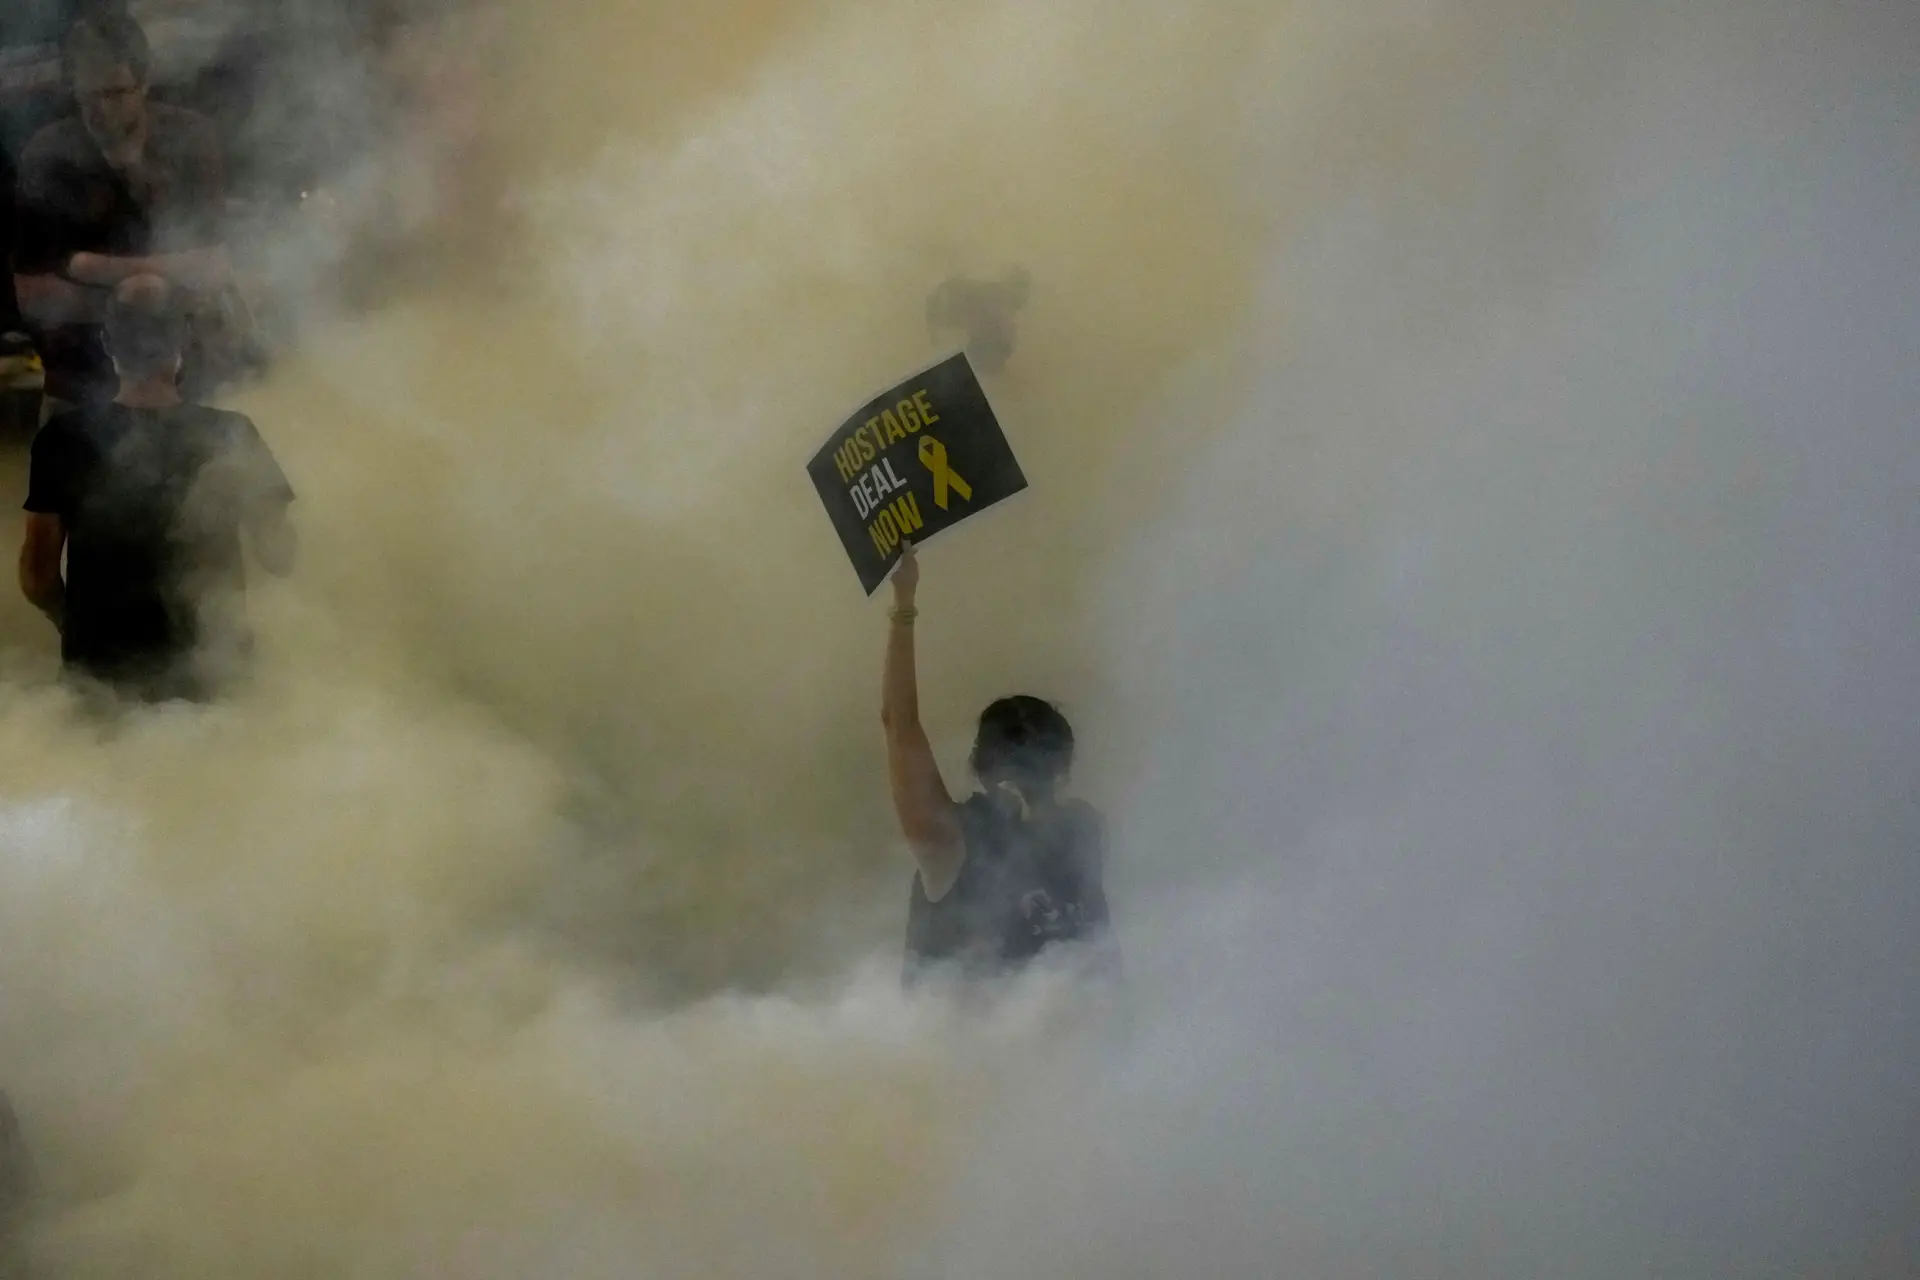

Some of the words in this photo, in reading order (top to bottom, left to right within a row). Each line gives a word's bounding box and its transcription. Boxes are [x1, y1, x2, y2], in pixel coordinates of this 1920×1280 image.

[833, 389, 940, 483] HOSTAGE
[850, 457, 907, 520] DEAL
[868, 491, 924, 560] NOW
